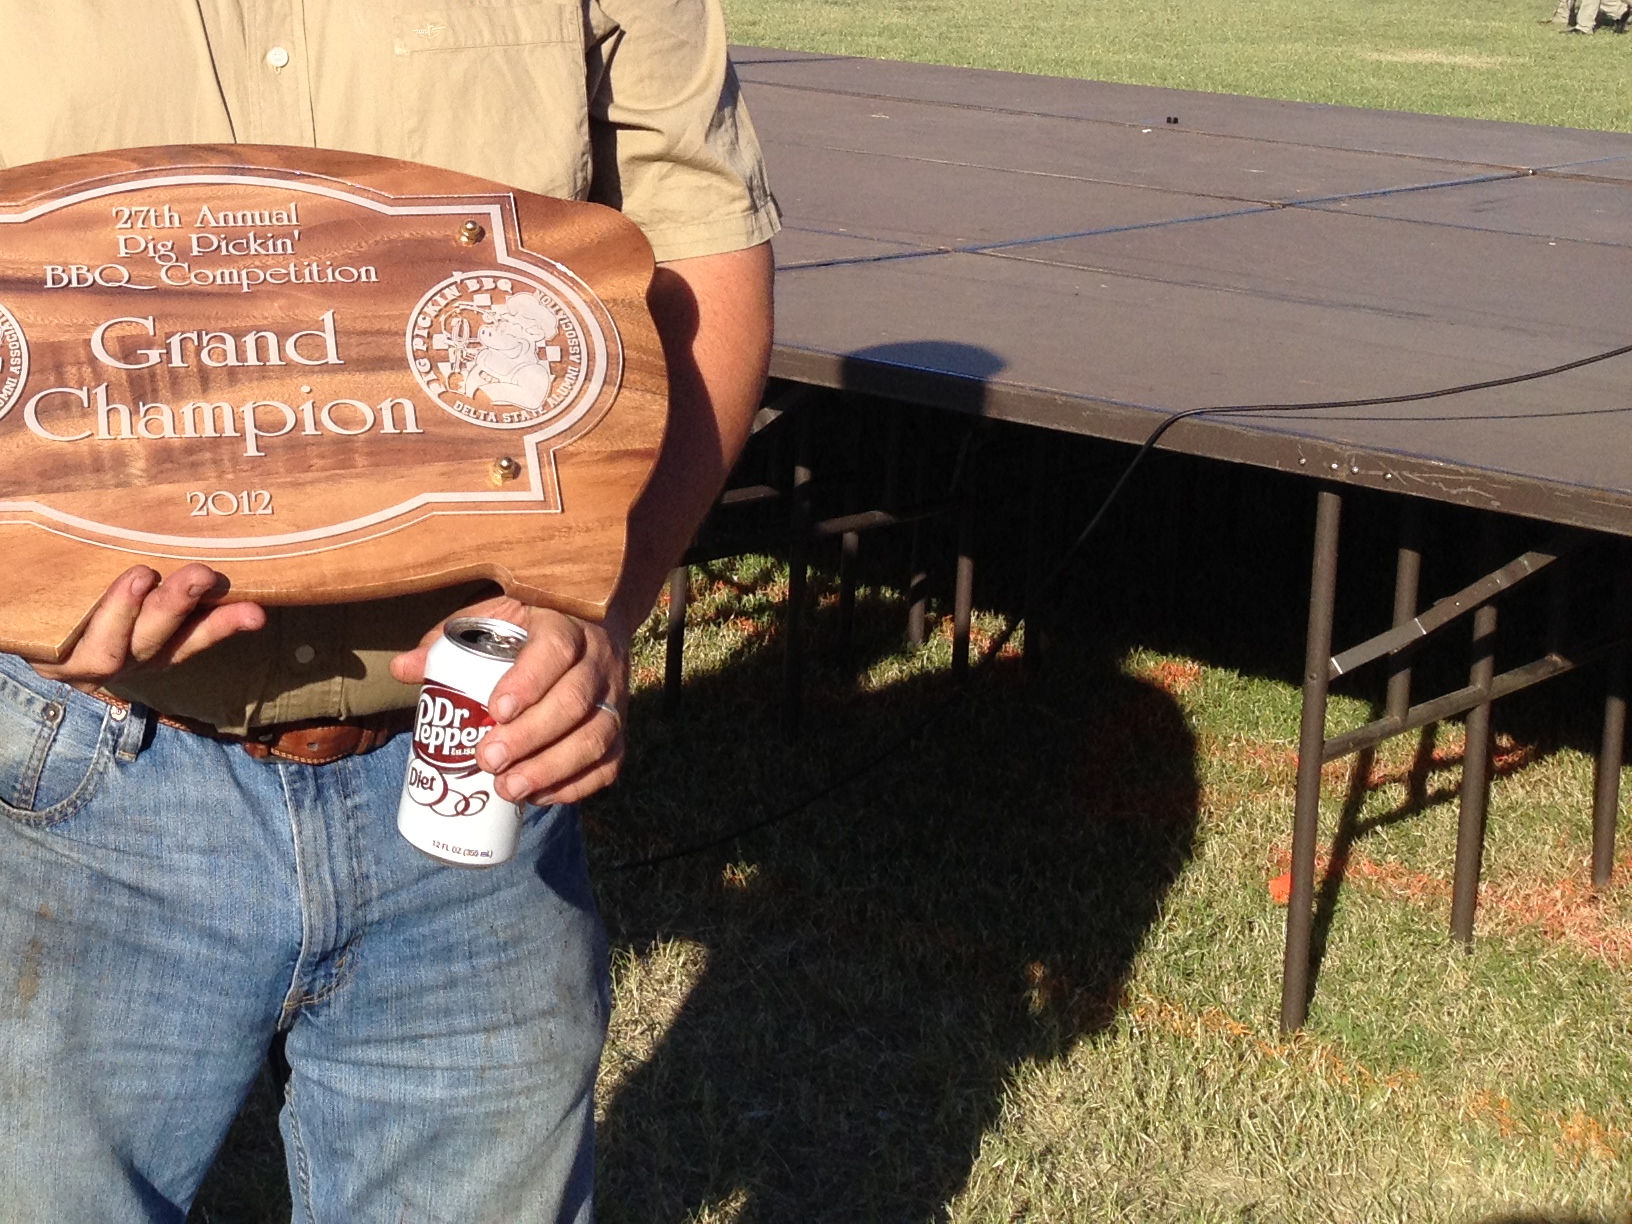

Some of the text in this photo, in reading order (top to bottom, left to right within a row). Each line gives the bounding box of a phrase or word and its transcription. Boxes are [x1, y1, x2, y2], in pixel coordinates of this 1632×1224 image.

[112, 201, 301, 229] 27th Annual
[117, 229, 301, 266] Pig Pickin'
[44, 261, 380, 293] BBQ Competition
[90, 309, 345, 370] Grand
[415, 358, 448, 396] PIG
[464, 277, 513, 294] BBQ
[533, 289, 581, 363] ASSOCIATION
[546, 366, 580, 409] ALUMNI
[23, 381, 425, 457] Champion
[453, 400, 497, 423] DELTA
[502, 406, 547, 423] STATE
[186, 489, 274, 517] 2012
[434, 696, 470, 727] Dr
[409, 766, 436, 792] Diet
[432, 839, 441, 849] 12
[441, 843, 449, 851] FL
[451, 845, 462, 855] OZ
